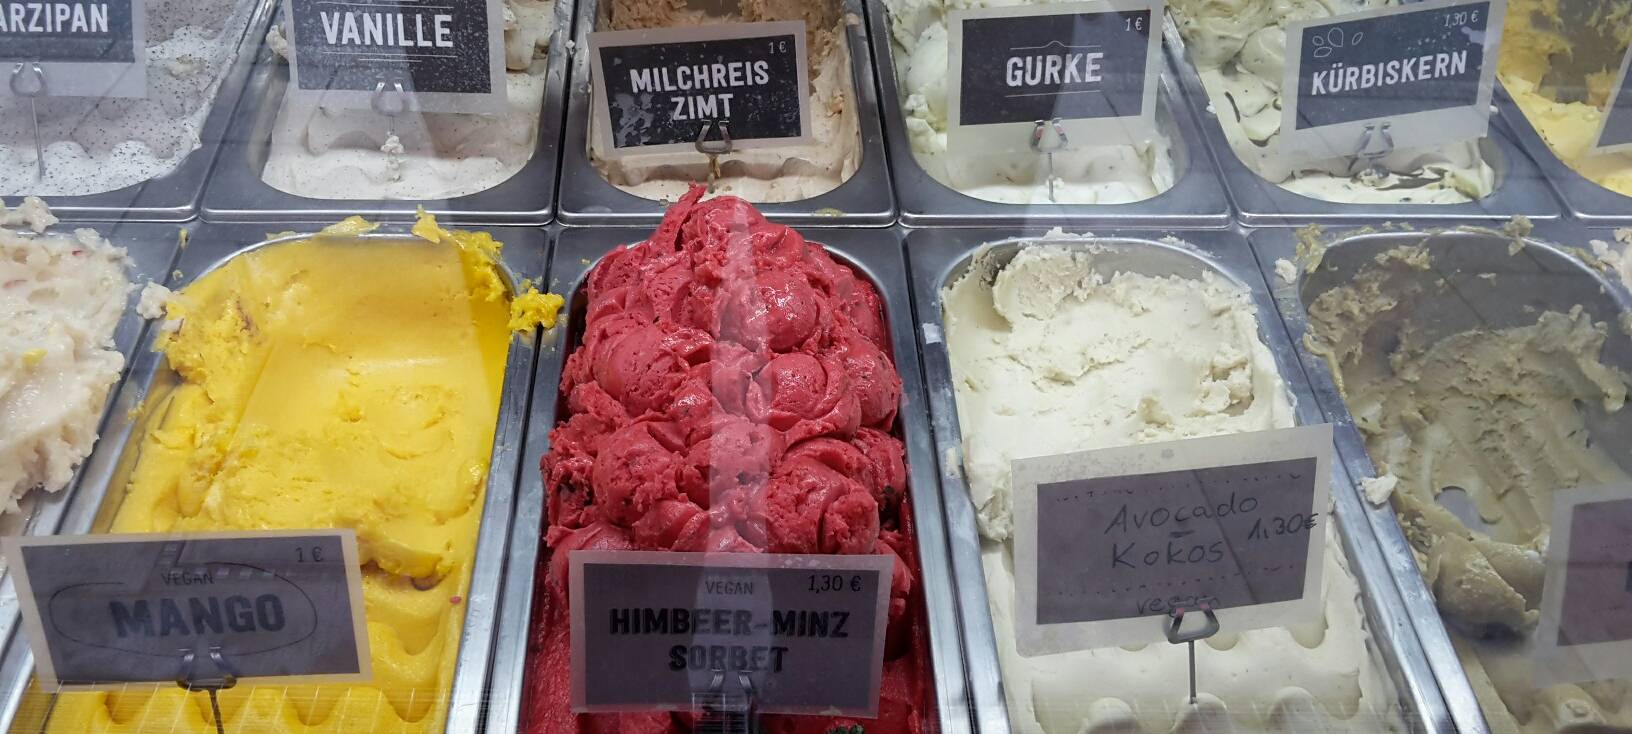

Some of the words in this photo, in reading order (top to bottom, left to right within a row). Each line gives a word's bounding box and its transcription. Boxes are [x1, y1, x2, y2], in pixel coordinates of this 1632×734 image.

[319, 12, 454, 48] VANILLE
[1125, 18, 1131, 30] 1
[1134, 17, 1142, 30] €
[1444, 12, 1467, 27] 1,30
[1470, 12, 1478, 24] €
[768, 41, 775, 54] 1
[779, 41, 787, 53] €
[629, 60, 770, 93] MILCHREIS
[1005, 51, 1103, 87] GURKE
[1311, 50, 1467, 96] KÜRBISKERN
[672, 93, 734, 121] ZIMT
[1104, 492, 1259, 535] Avocado
[296, 547, 304, 562] 1
[313, 546, 324, 562] €
[161, 571, 214, 587] VEGAN
[705, 580, 754, 595] VEGAN
[807, 574, 843, 595] 1,30
[850, 575, 861, 592] €
[110, 593, 286, 638] MANGO
[608, 607, 850, 638] HIMBEER-MINZ
[668, 644, 789, 673] SORBET
